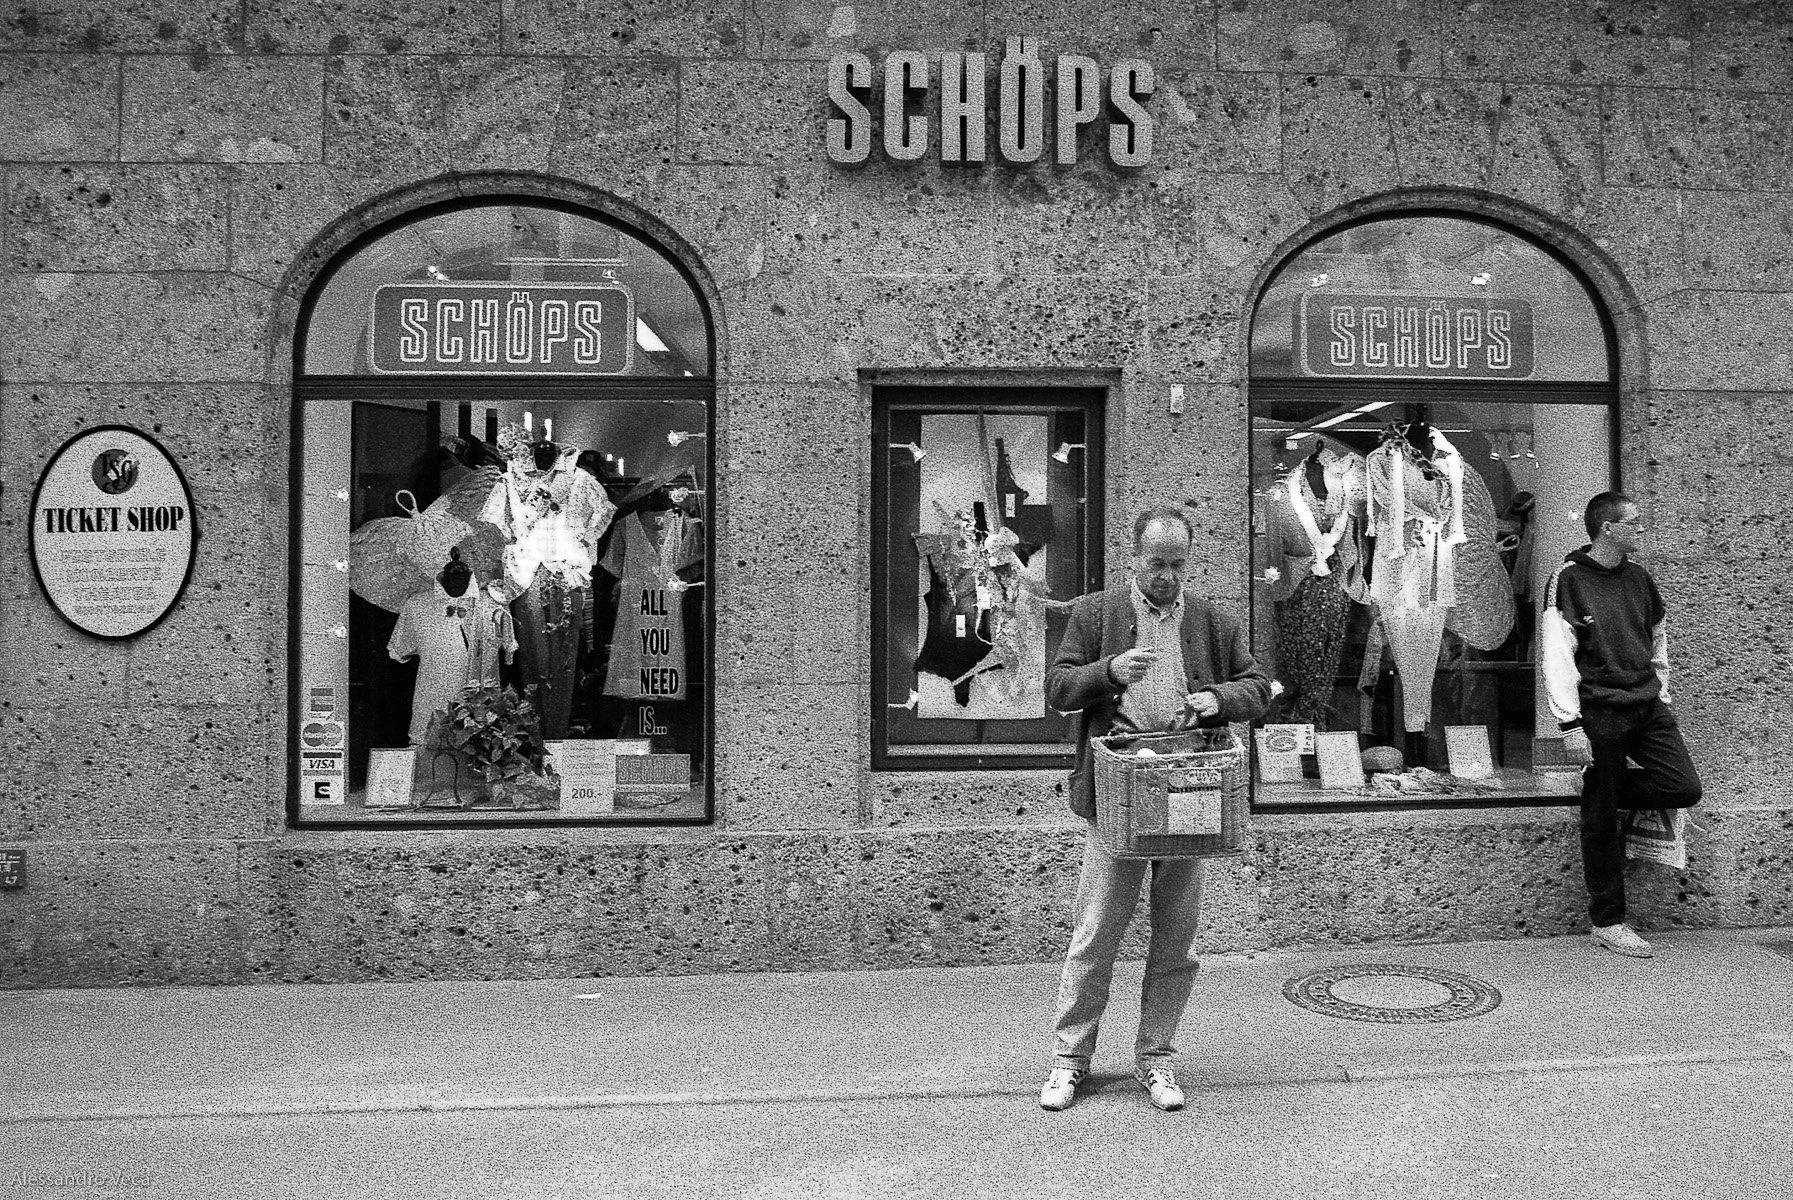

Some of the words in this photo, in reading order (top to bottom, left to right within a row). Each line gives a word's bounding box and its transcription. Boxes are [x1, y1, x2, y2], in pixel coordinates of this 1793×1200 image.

[827, 36, 1154, 167] SCHÖPS
[400, 292, 601, 364] SCHÖPS
[1331, 300, 1511, 370] SCHÖPS
[43, 506, 121, 534] TICKET
[127, 505, 184, 532] SHOP
[640, 589, 668, 616] ALL
[640, 628, 670, 656] YOU
[640, 668, 679, 695] NEED
[639, 705, 668, 735] IS...
[309, 759, 335, 769] VISA
